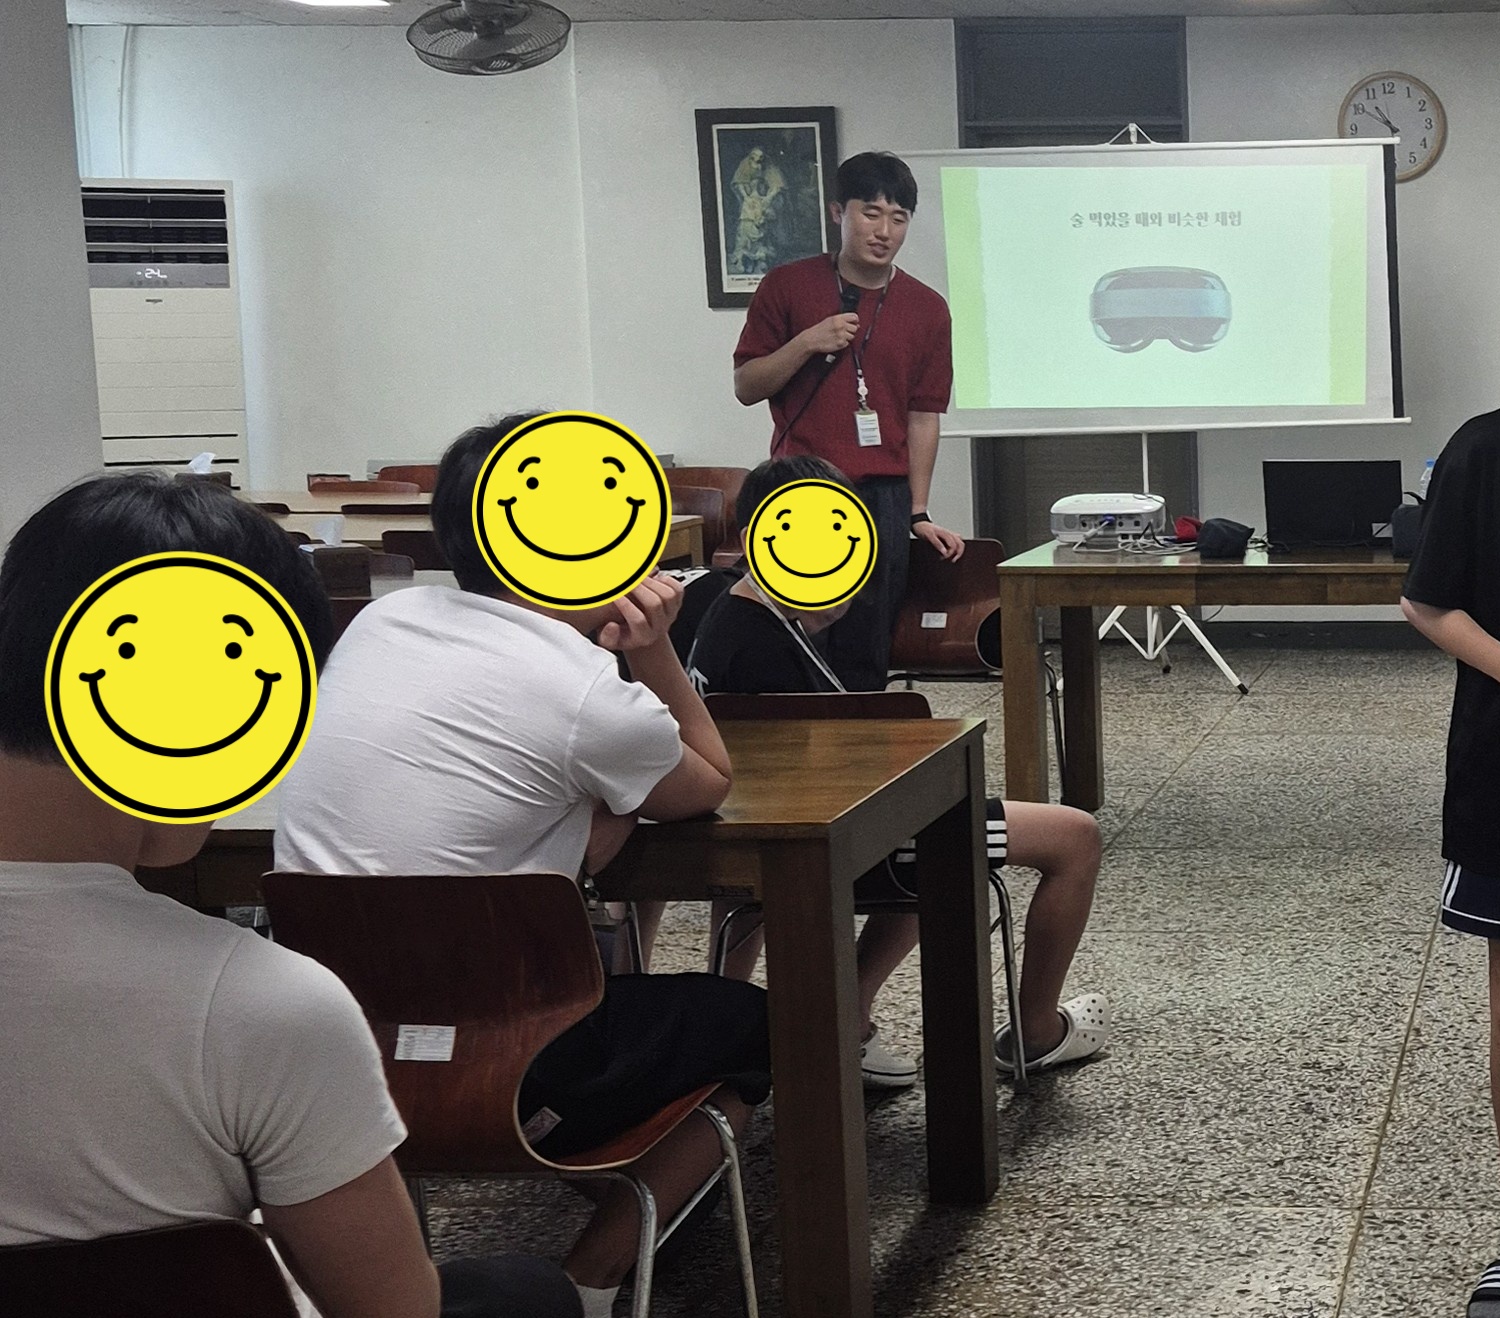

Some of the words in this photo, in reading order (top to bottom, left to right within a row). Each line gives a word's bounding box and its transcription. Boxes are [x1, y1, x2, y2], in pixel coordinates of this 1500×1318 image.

[1365, 88, 1376, 100] 11
[1382, 82, 1395, 94] 12
[1406, 86, 1412, 98] 1
[1353, 103, 1365, 115] 10
[1418, 100, 1427, 112] 2
[1350, 123, 1358, 135] 9
[1425, 118, 1433, 130] 3
[1420, 137, 1427, 149] 4
[1409, 152, 1417, 164] 5
[1070, 212, 1085, 228] 술
[1089, 211, 1130, 228] 먹었을
[1168, 211, 1209, 228] 비슷한
